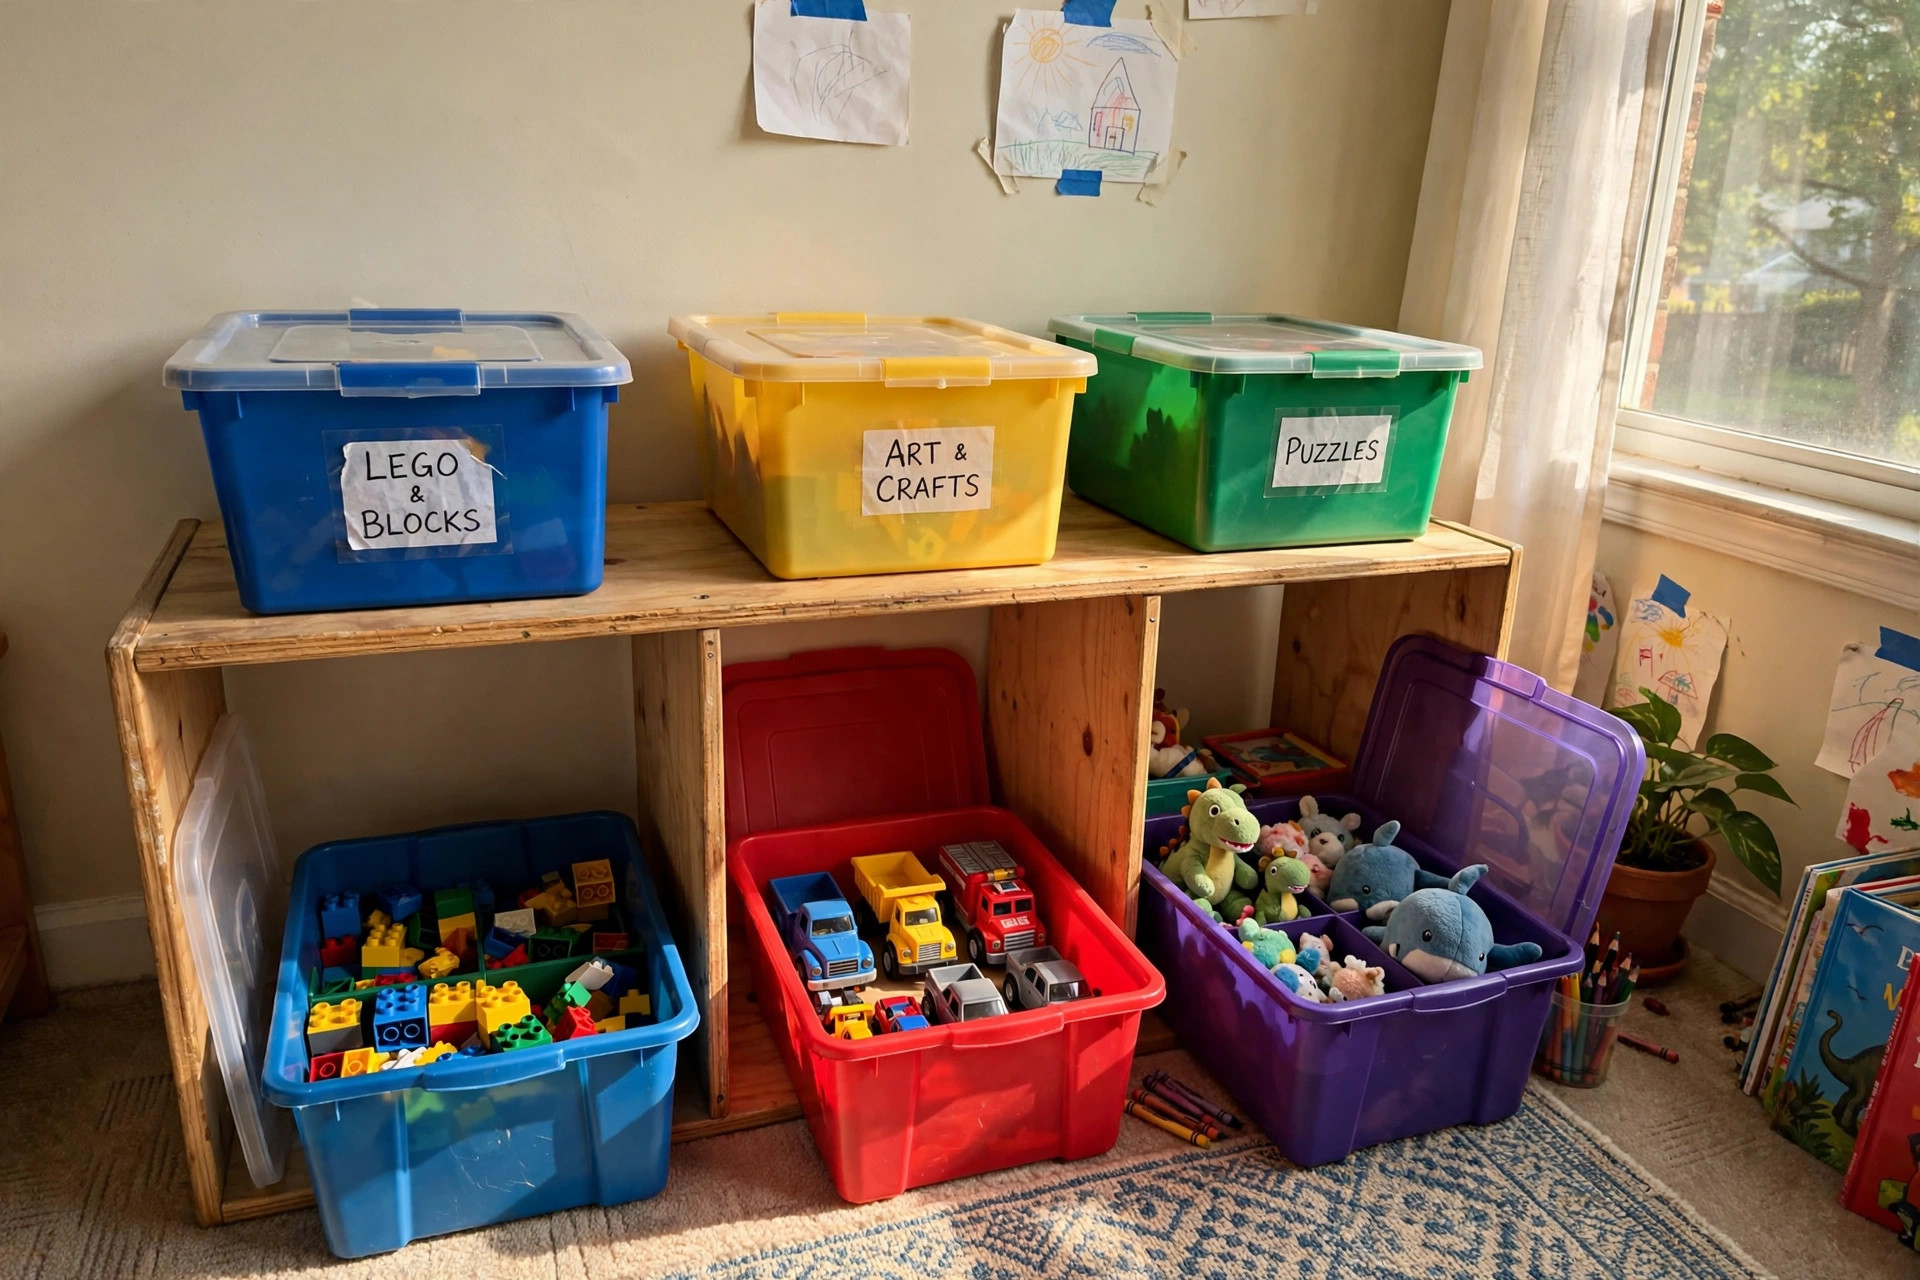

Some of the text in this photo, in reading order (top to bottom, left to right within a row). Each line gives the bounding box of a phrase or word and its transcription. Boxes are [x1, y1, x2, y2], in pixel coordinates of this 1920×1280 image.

[365, 450, 459, 481] LEGO
[885, 438, 968, 468] ART &
[1285, 436, 1379, 466] PUZZLES
[410, 485, 425, 503] &
[876, 473, 980, 503] CRAFTS
[361, 508, 481, 540] BLOCKS
